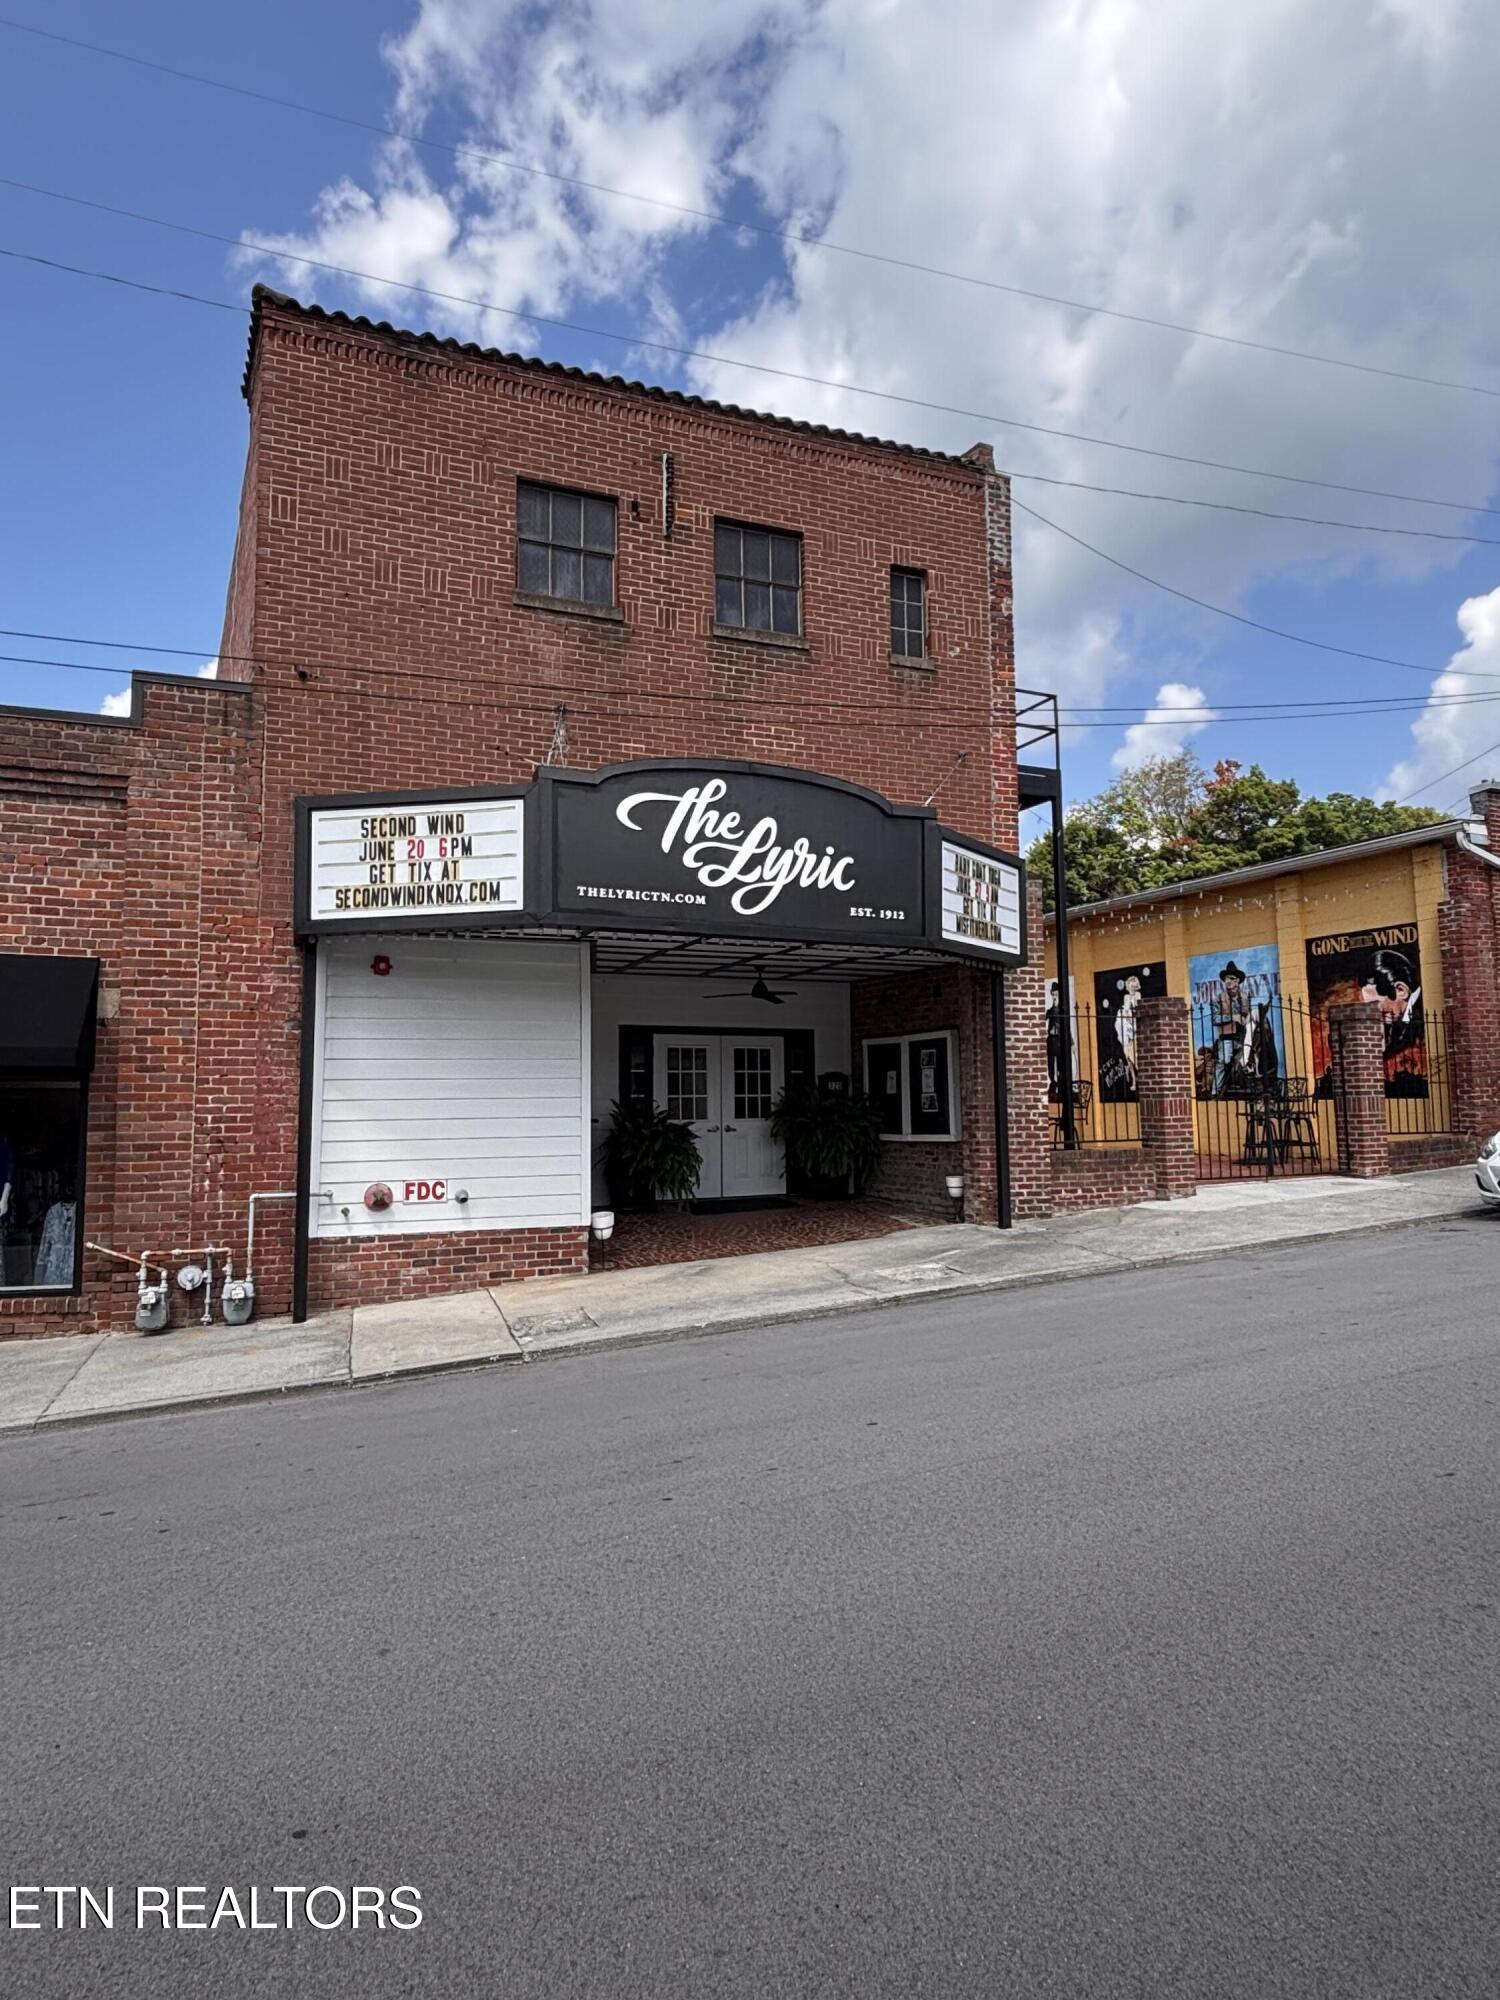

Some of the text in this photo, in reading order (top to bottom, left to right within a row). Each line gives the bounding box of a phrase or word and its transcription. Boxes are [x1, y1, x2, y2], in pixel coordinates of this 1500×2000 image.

[360, 813, 465, 839] SECOND WIND
[359, 840, 396, 862] JUNE
[407, 839, 425, 860] 20
[615, 777, 856, 916] The Lyric
[369, 860, 460, 885] GET TIX AT
[335, 880, 501, 909] SECONDWINDKNOX.COM
[576, 885, 707, 905] THELYRICTN.COM
[850, 906, 876, 919] EST.
[1311, 935, 1350, 956] GONE
[1373, 926, 1418, 947] WIND
[1239, 971, 1280, 997] AYNE
[404, 1181, 446, 1201] FDC
